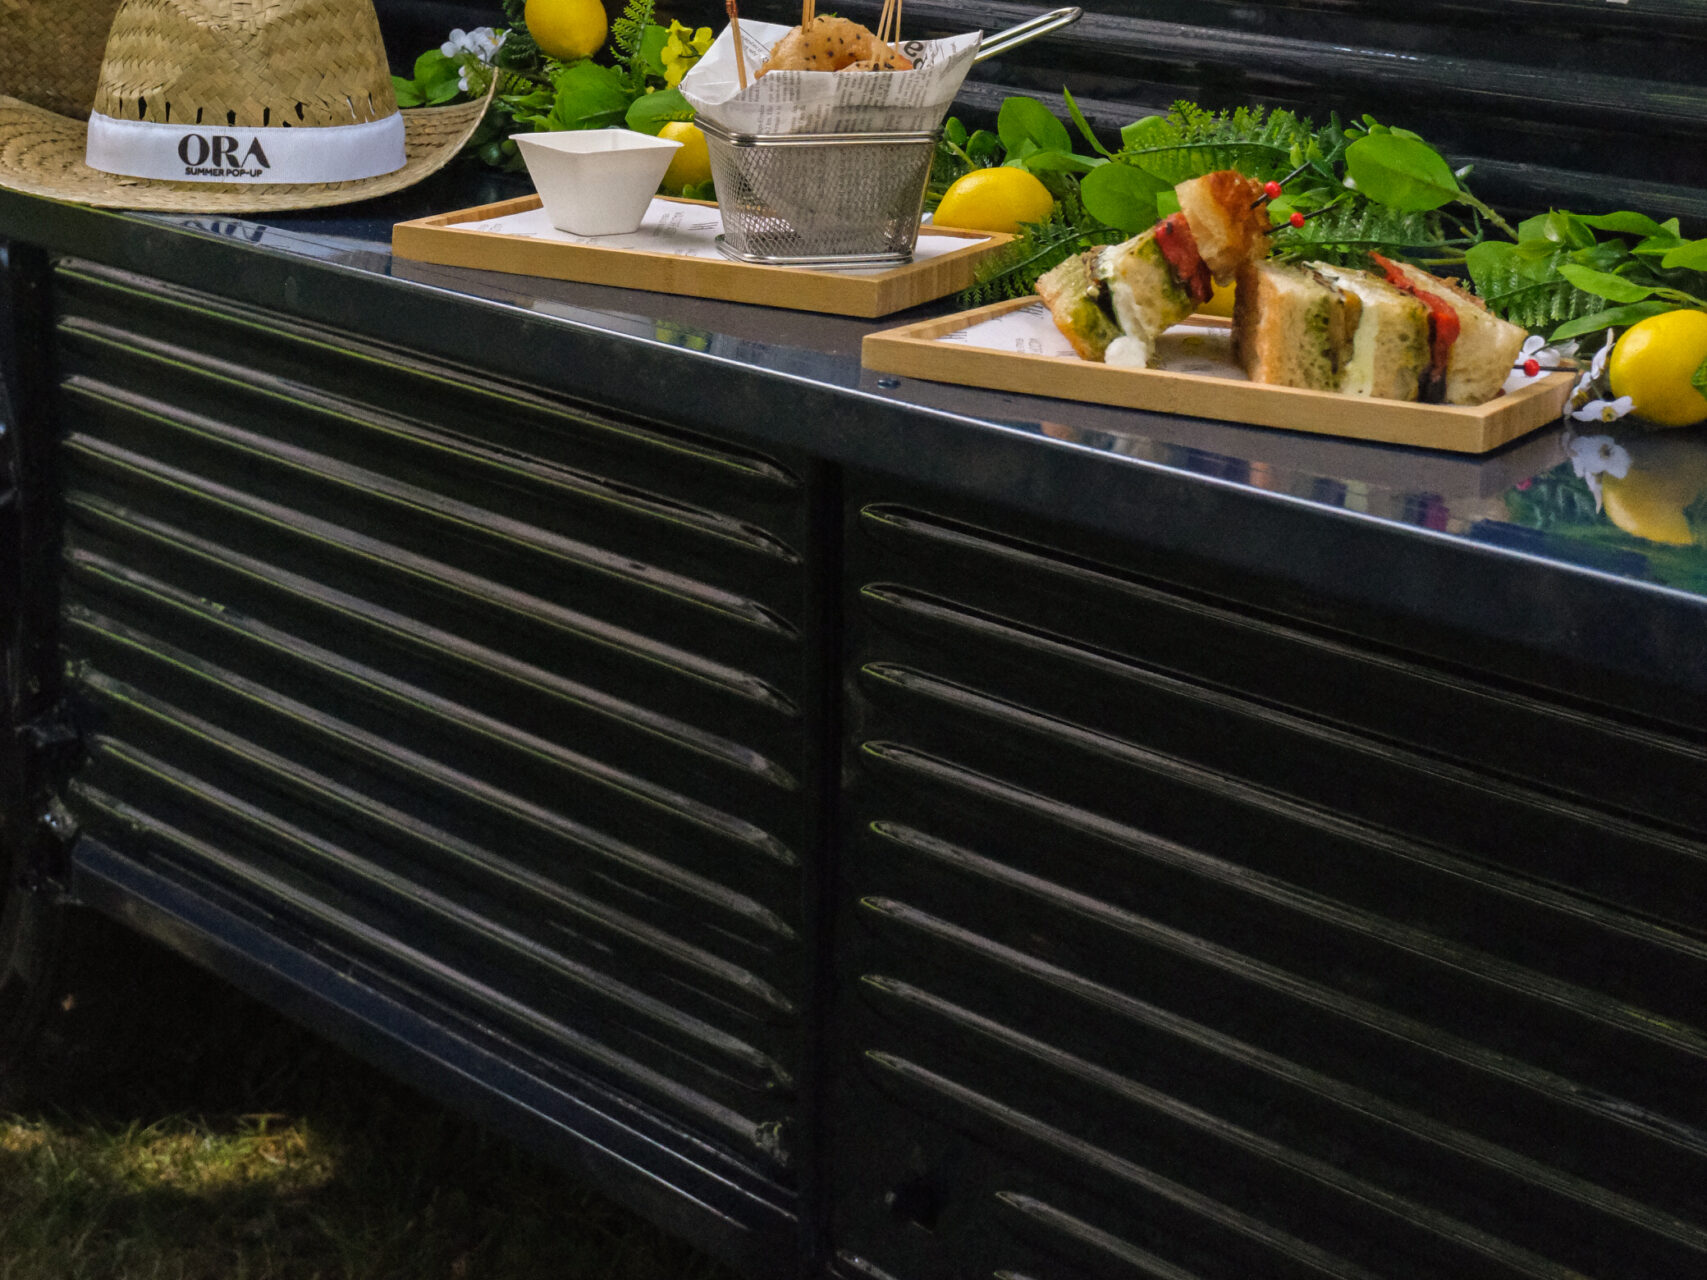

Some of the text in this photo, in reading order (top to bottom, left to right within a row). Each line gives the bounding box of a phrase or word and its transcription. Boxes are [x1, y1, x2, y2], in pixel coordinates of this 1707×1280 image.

[178, 134, 270, 168] ORA
[185, 167, 263, 177] SUMMER POP-UP
